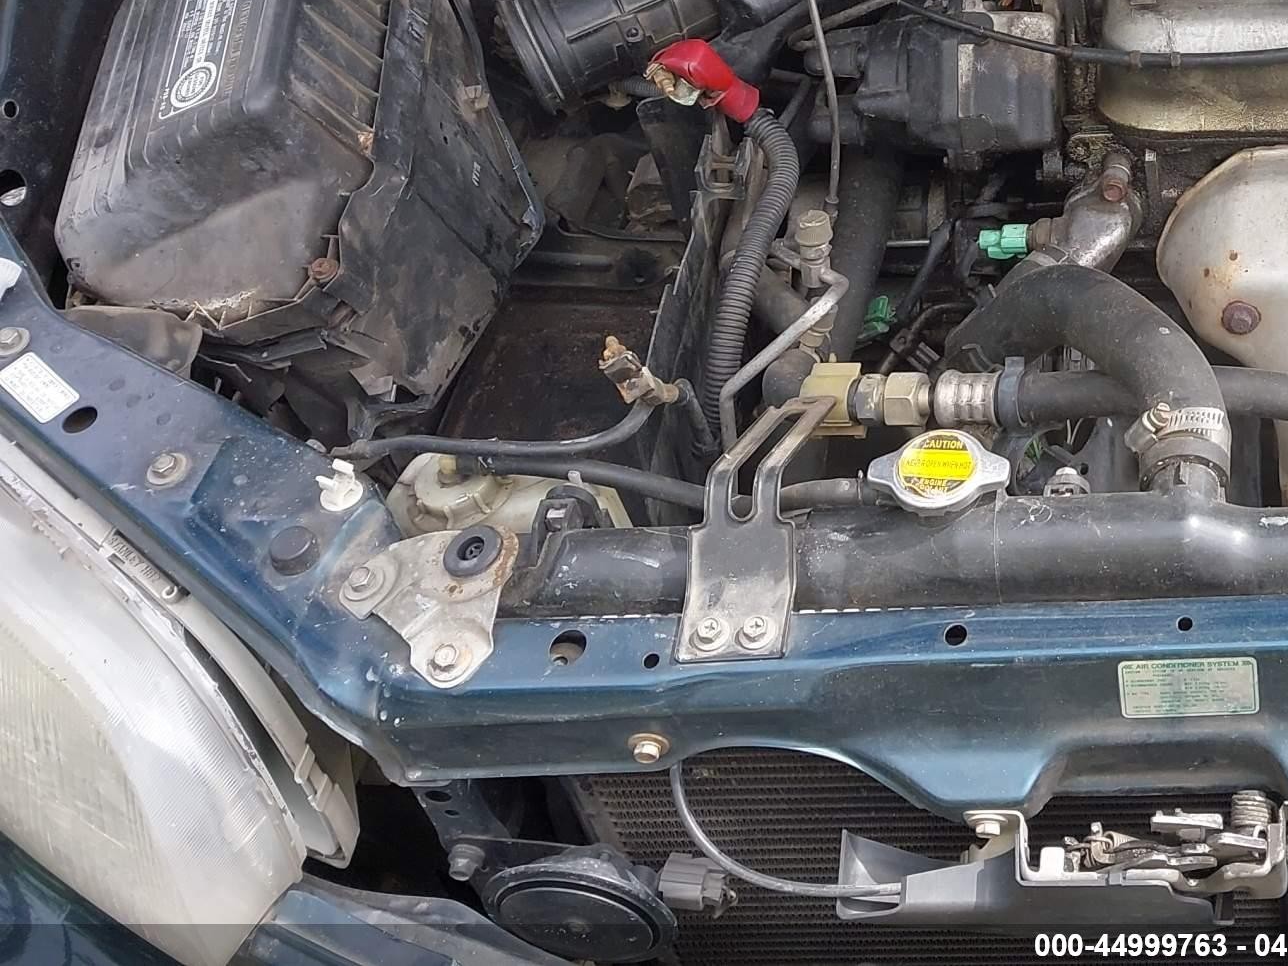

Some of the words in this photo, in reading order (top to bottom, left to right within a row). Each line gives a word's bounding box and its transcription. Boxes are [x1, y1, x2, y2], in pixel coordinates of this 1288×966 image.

[922, 439, 963, 450] CAUTION
[1151, 661, 1205, 670] CONDITIONER
[1207, 660, 1239, 668] SYSTEM
